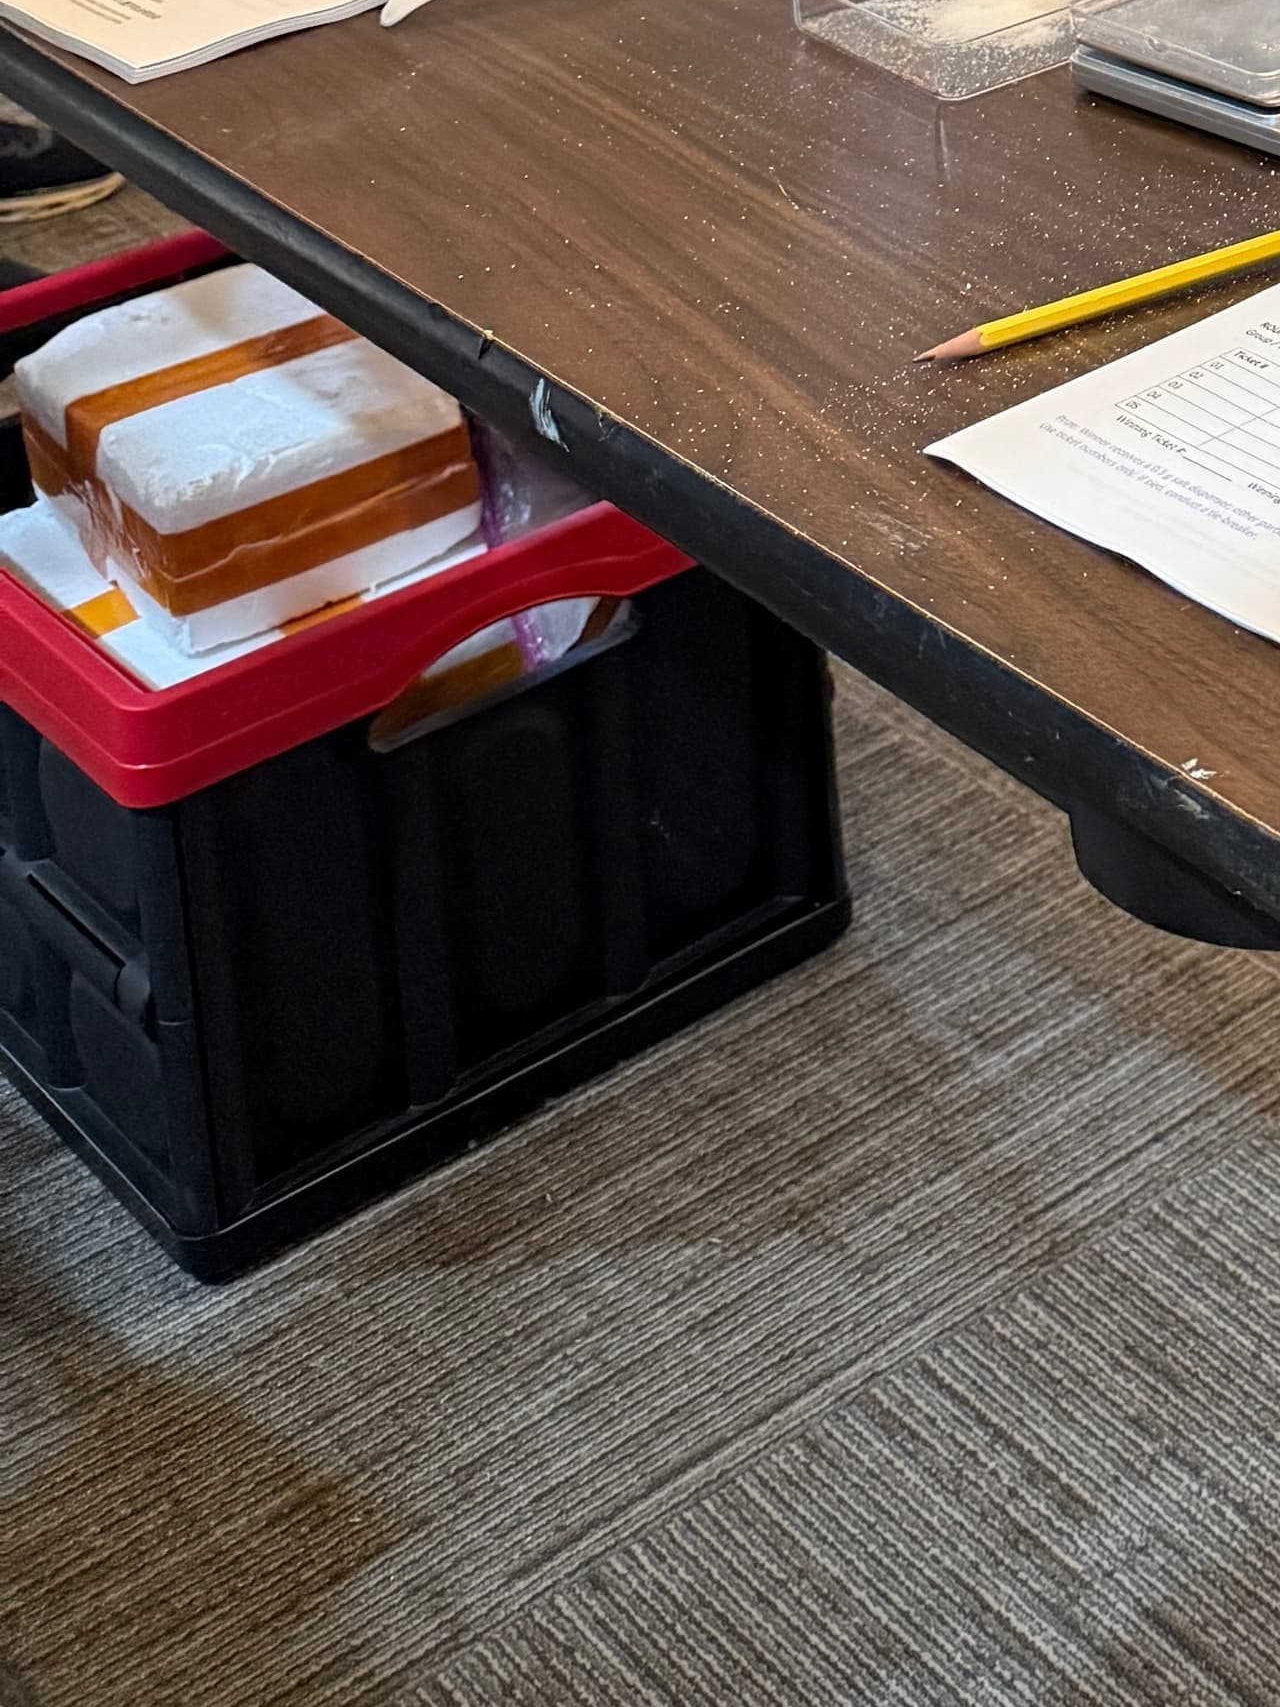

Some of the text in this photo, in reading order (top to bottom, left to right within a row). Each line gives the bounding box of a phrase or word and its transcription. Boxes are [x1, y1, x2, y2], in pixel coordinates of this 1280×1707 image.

[1234, 351, 1262, 367] Ticket
[1209, 361, 1224, 370] 01
[1188, 371, 1204, 379] 02
[1168, 381, 1184, 390] 03
[1146, 391, 1162, 399] 04
[1125, 401, 1141, 409] 05
